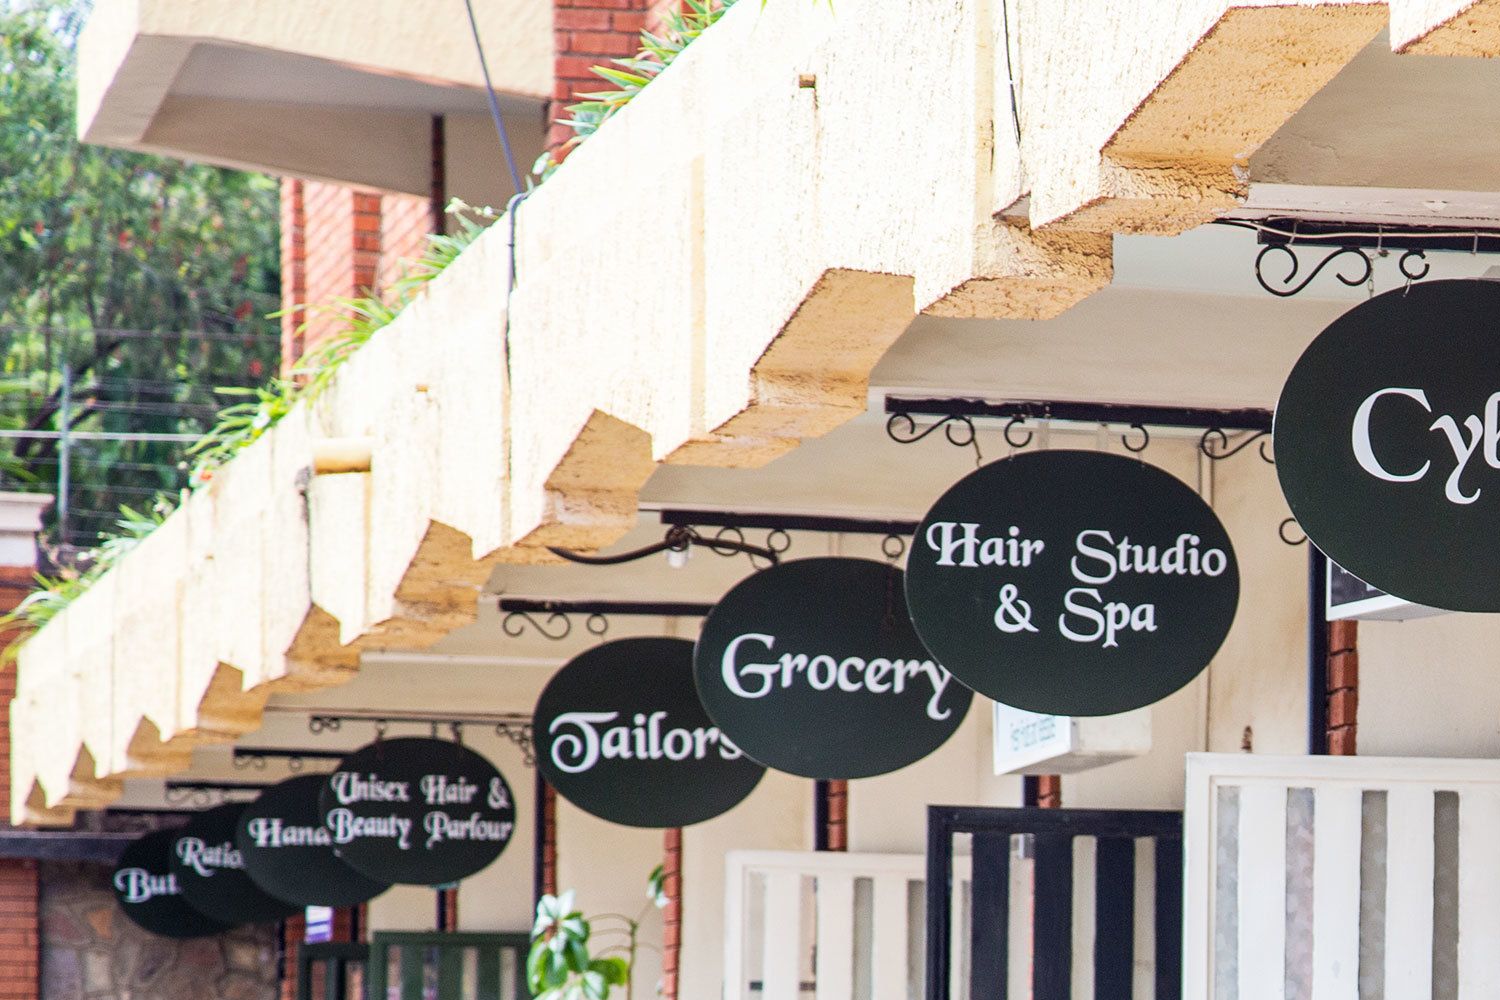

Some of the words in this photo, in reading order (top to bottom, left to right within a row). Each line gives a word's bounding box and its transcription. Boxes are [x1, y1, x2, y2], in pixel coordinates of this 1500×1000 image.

[926, 521, 1045, 568] Hair
[1070, 529, 1227, 585] Studio
[994, 583, 1040, 633] &
[1058, 587, 1158, 649] Spa
[721, 633, 952, 721] Grocery
[549, 711, 742, 774] Tailors
[331, 771, 410, 804] Unisex
[420, 774, 478, 804] Hair
[487, 776, 511, 809] &
[327, 808, 411, 850] Beauty
[423, 811, 512, 850] Parlour
